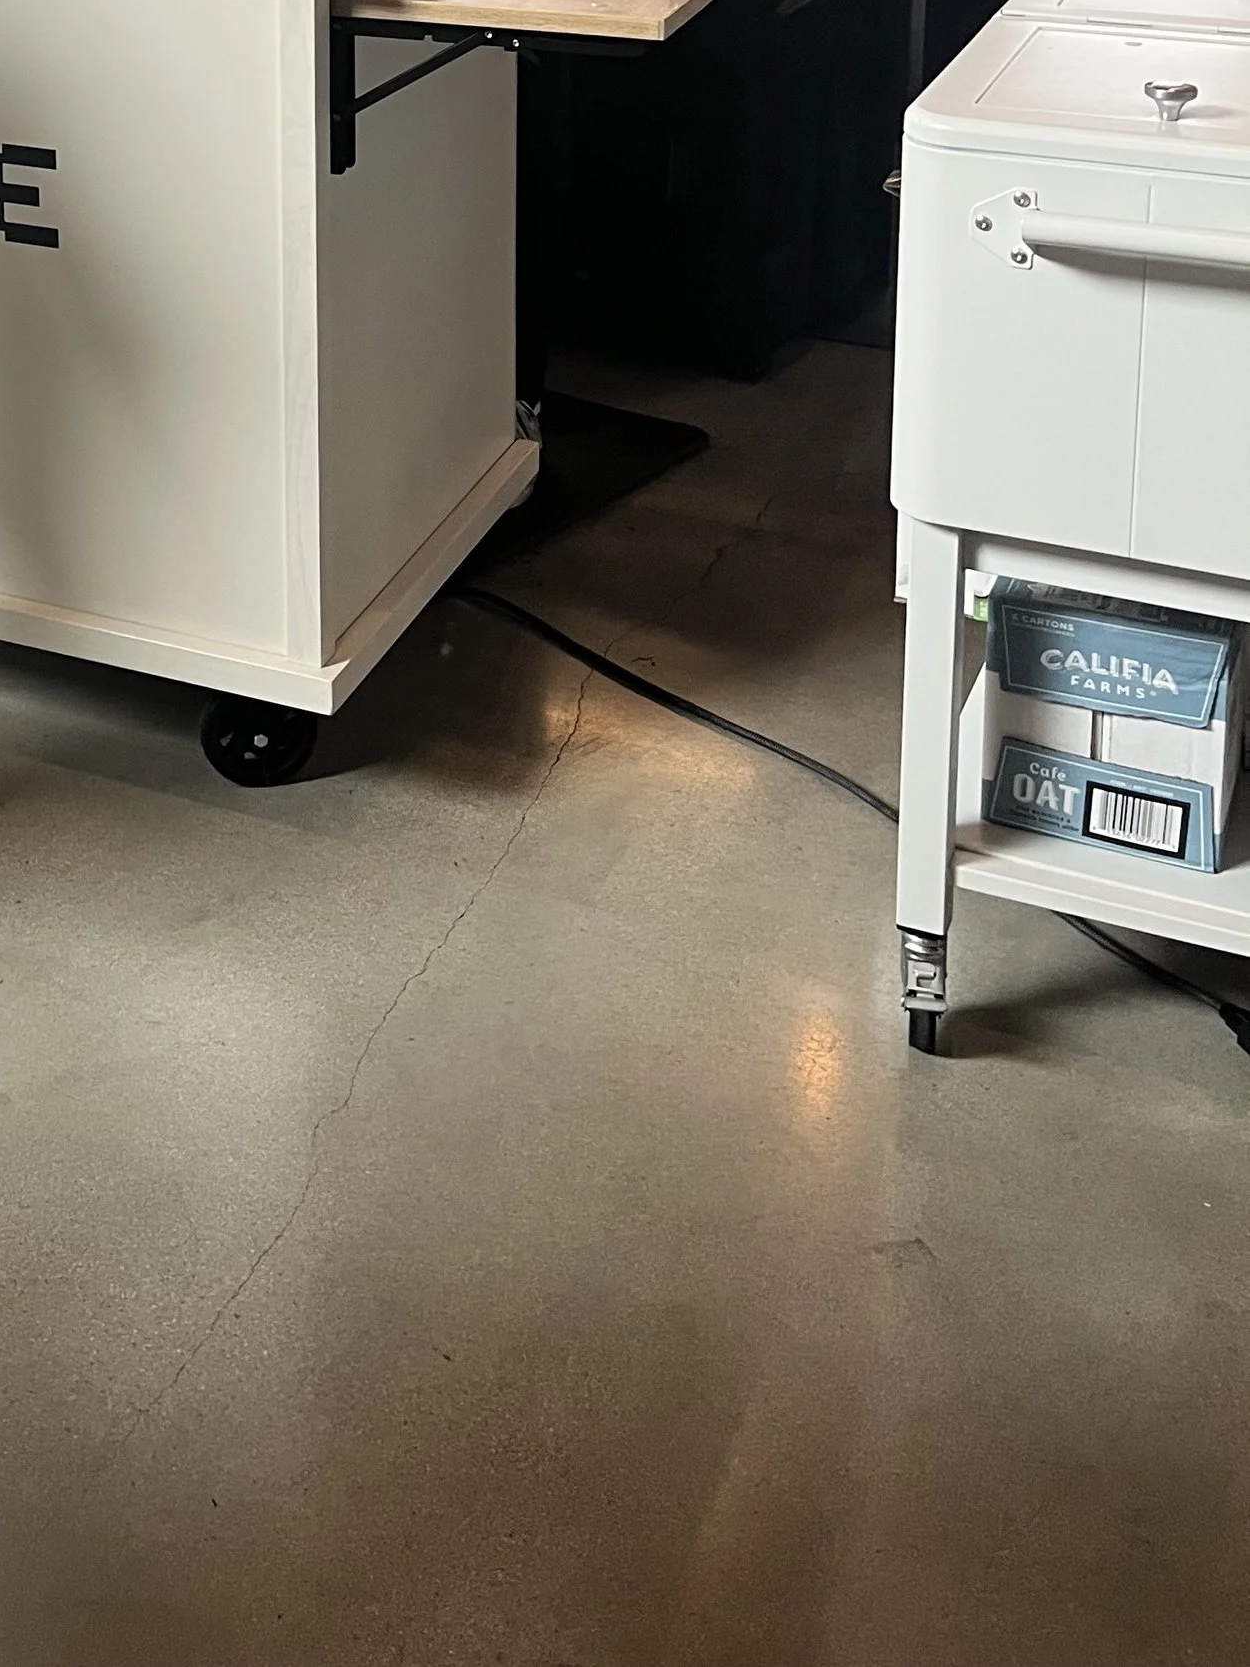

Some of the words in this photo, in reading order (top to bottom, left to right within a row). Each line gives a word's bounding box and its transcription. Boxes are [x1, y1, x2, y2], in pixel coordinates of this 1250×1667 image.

[1021, 615, 1075, 632] CARTONS
[1040, 648, 1179, 696] CALIFIA
[1070, 675, 1146, 699] FARMS
[1029, 761, 1067, 782] Café
[1012, 773, 1082, 816] OAT
